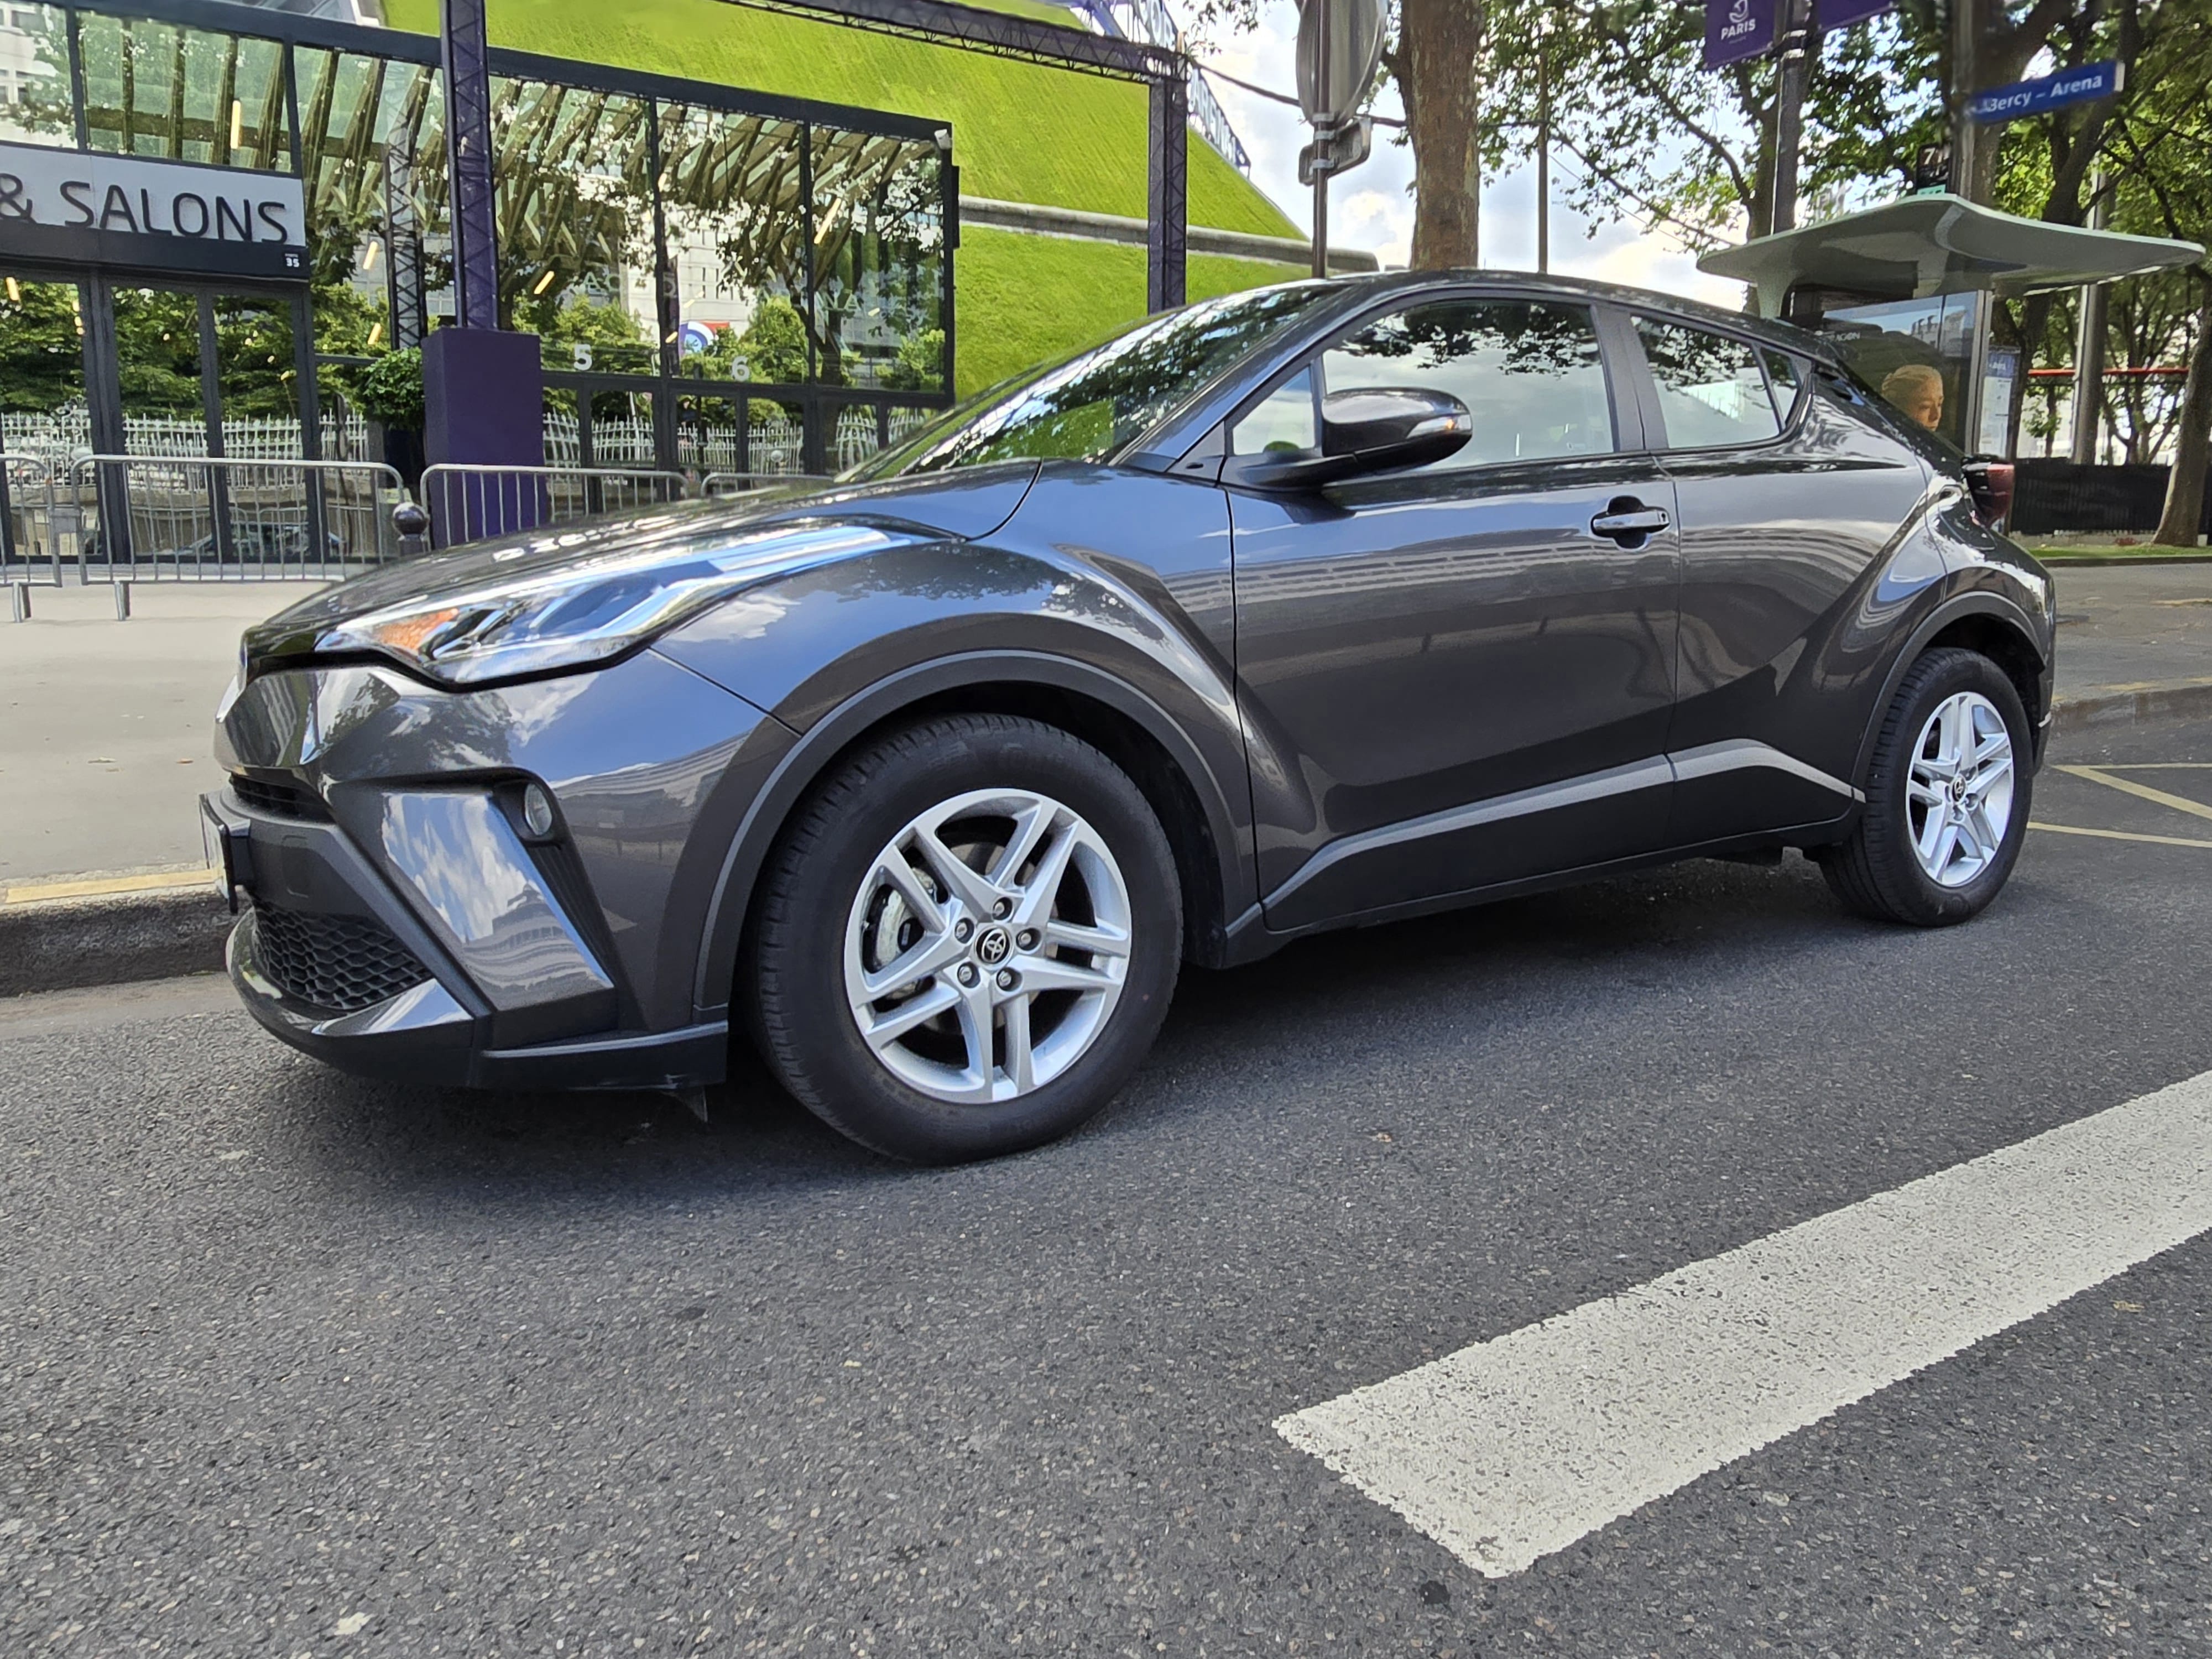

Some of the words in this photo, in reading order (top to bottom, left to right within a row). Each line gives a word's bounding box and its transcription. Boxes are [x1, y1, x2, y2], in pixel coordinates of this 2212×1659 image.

[1721, 18, 1756, 40] PARIS
[1987, 91, 2032, 112] Bercy
[2049, 75, 2103, 97] Arena
[60, 180, 288, 244] SALONS
[286, 257, 300, 268] 35
[573, 344, 592, 371] 5
[732, 356, 750, 381] 6
